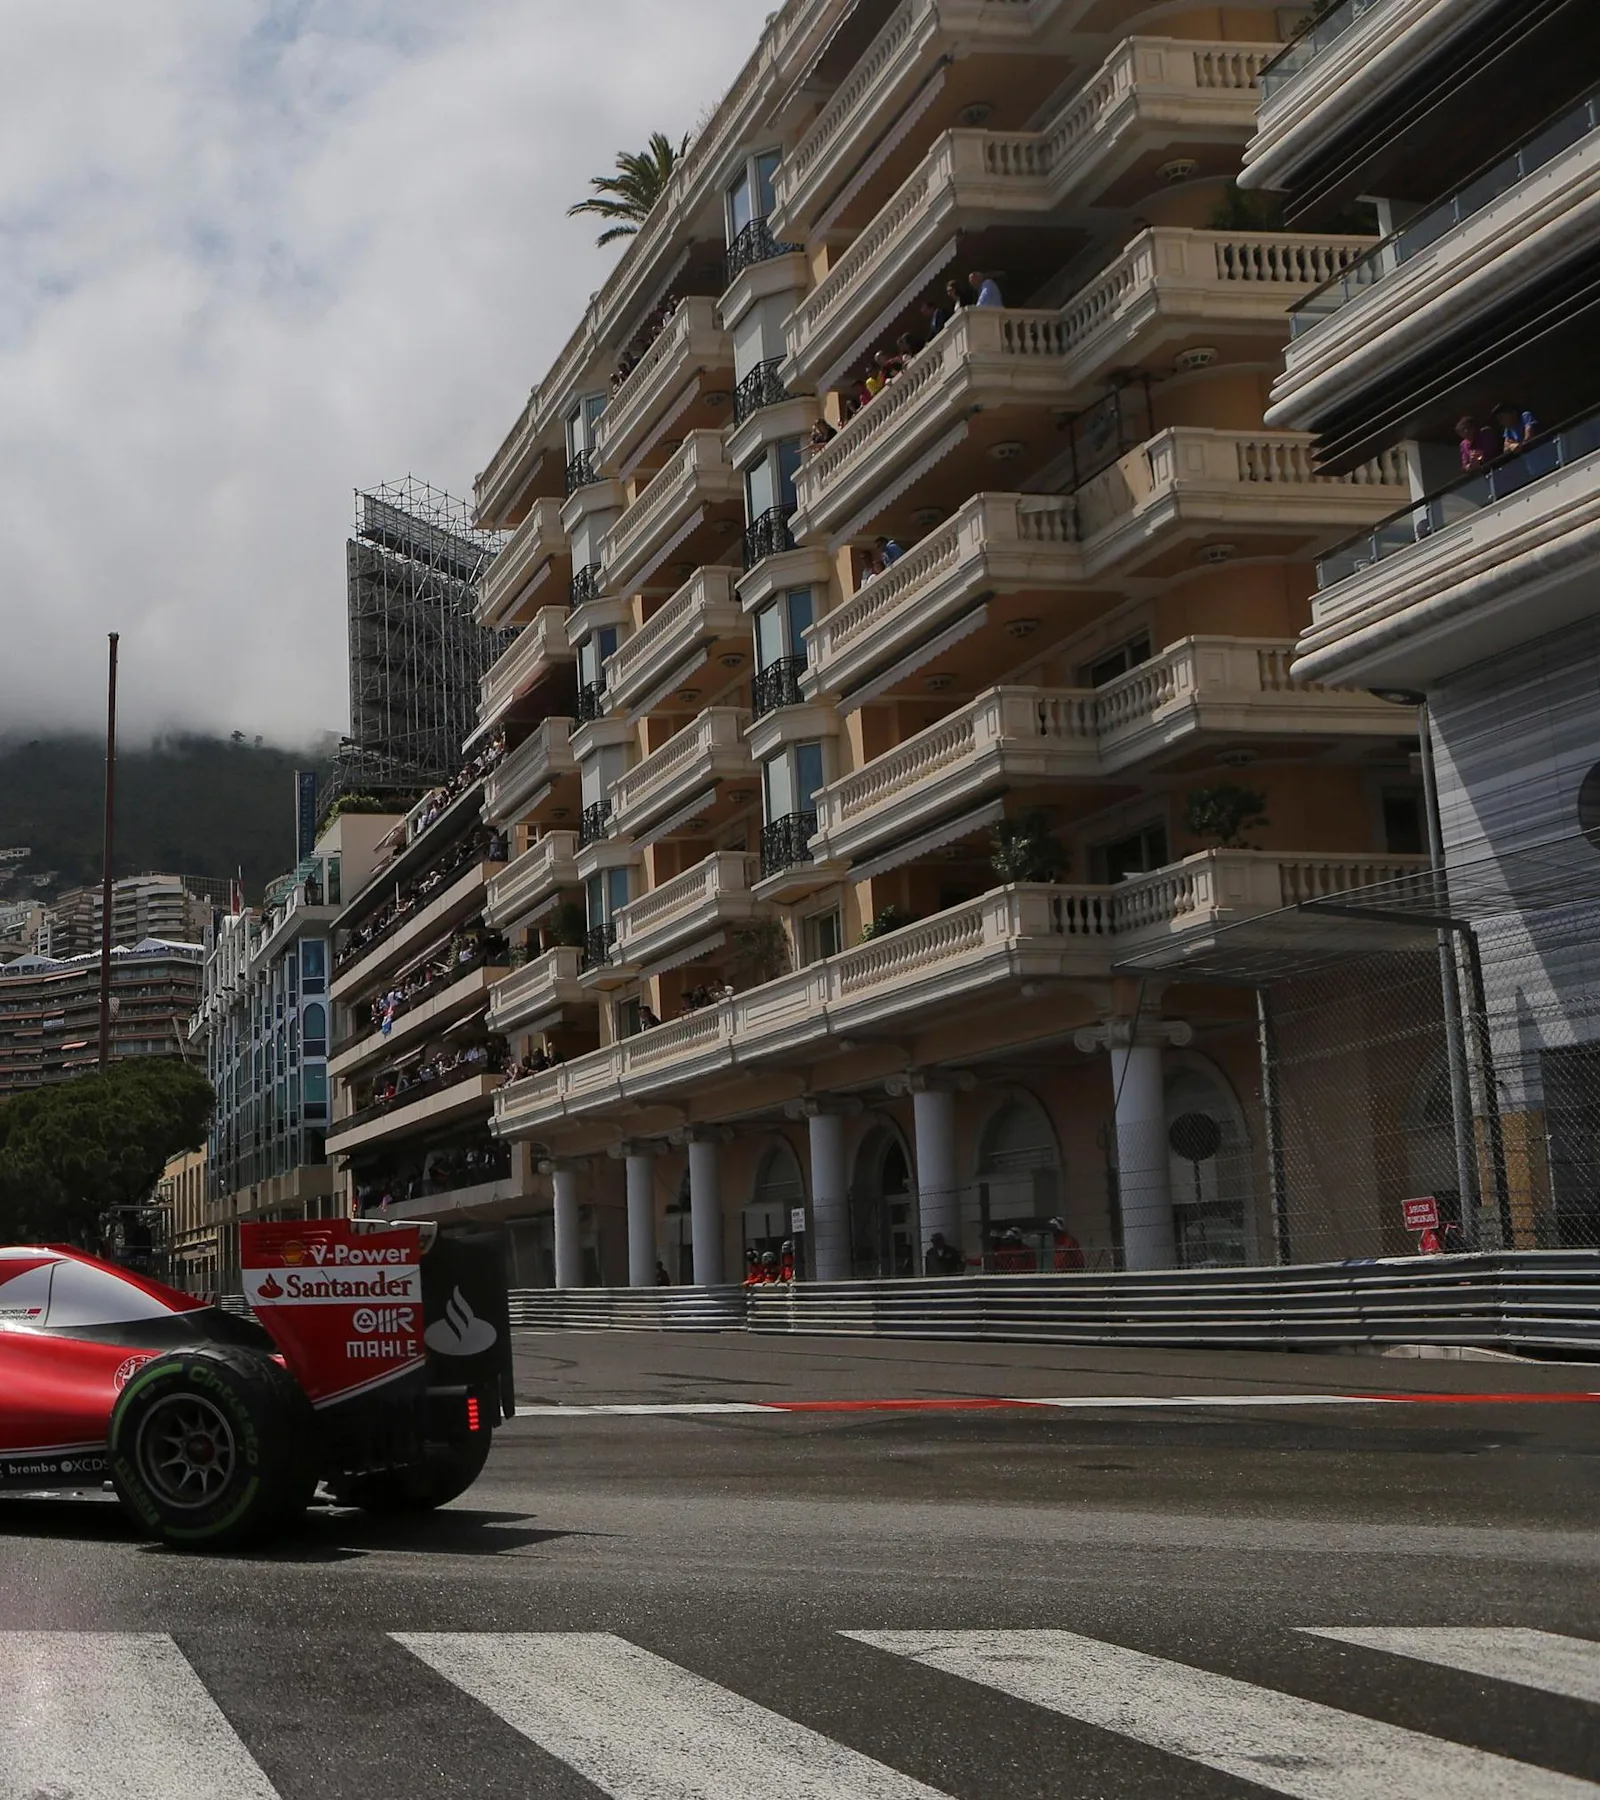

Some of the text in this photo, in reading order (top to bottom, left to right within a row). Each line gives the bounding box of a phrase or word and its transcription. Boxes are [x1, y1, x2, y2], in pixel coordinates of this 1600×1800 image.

[311, 1245, 410, 1264] V-Power
[286, 1271, 412, 1298] Santander
[346, 1339, 417, 1358] MAHLE
[8, 1461, 57, 1474] brembo
